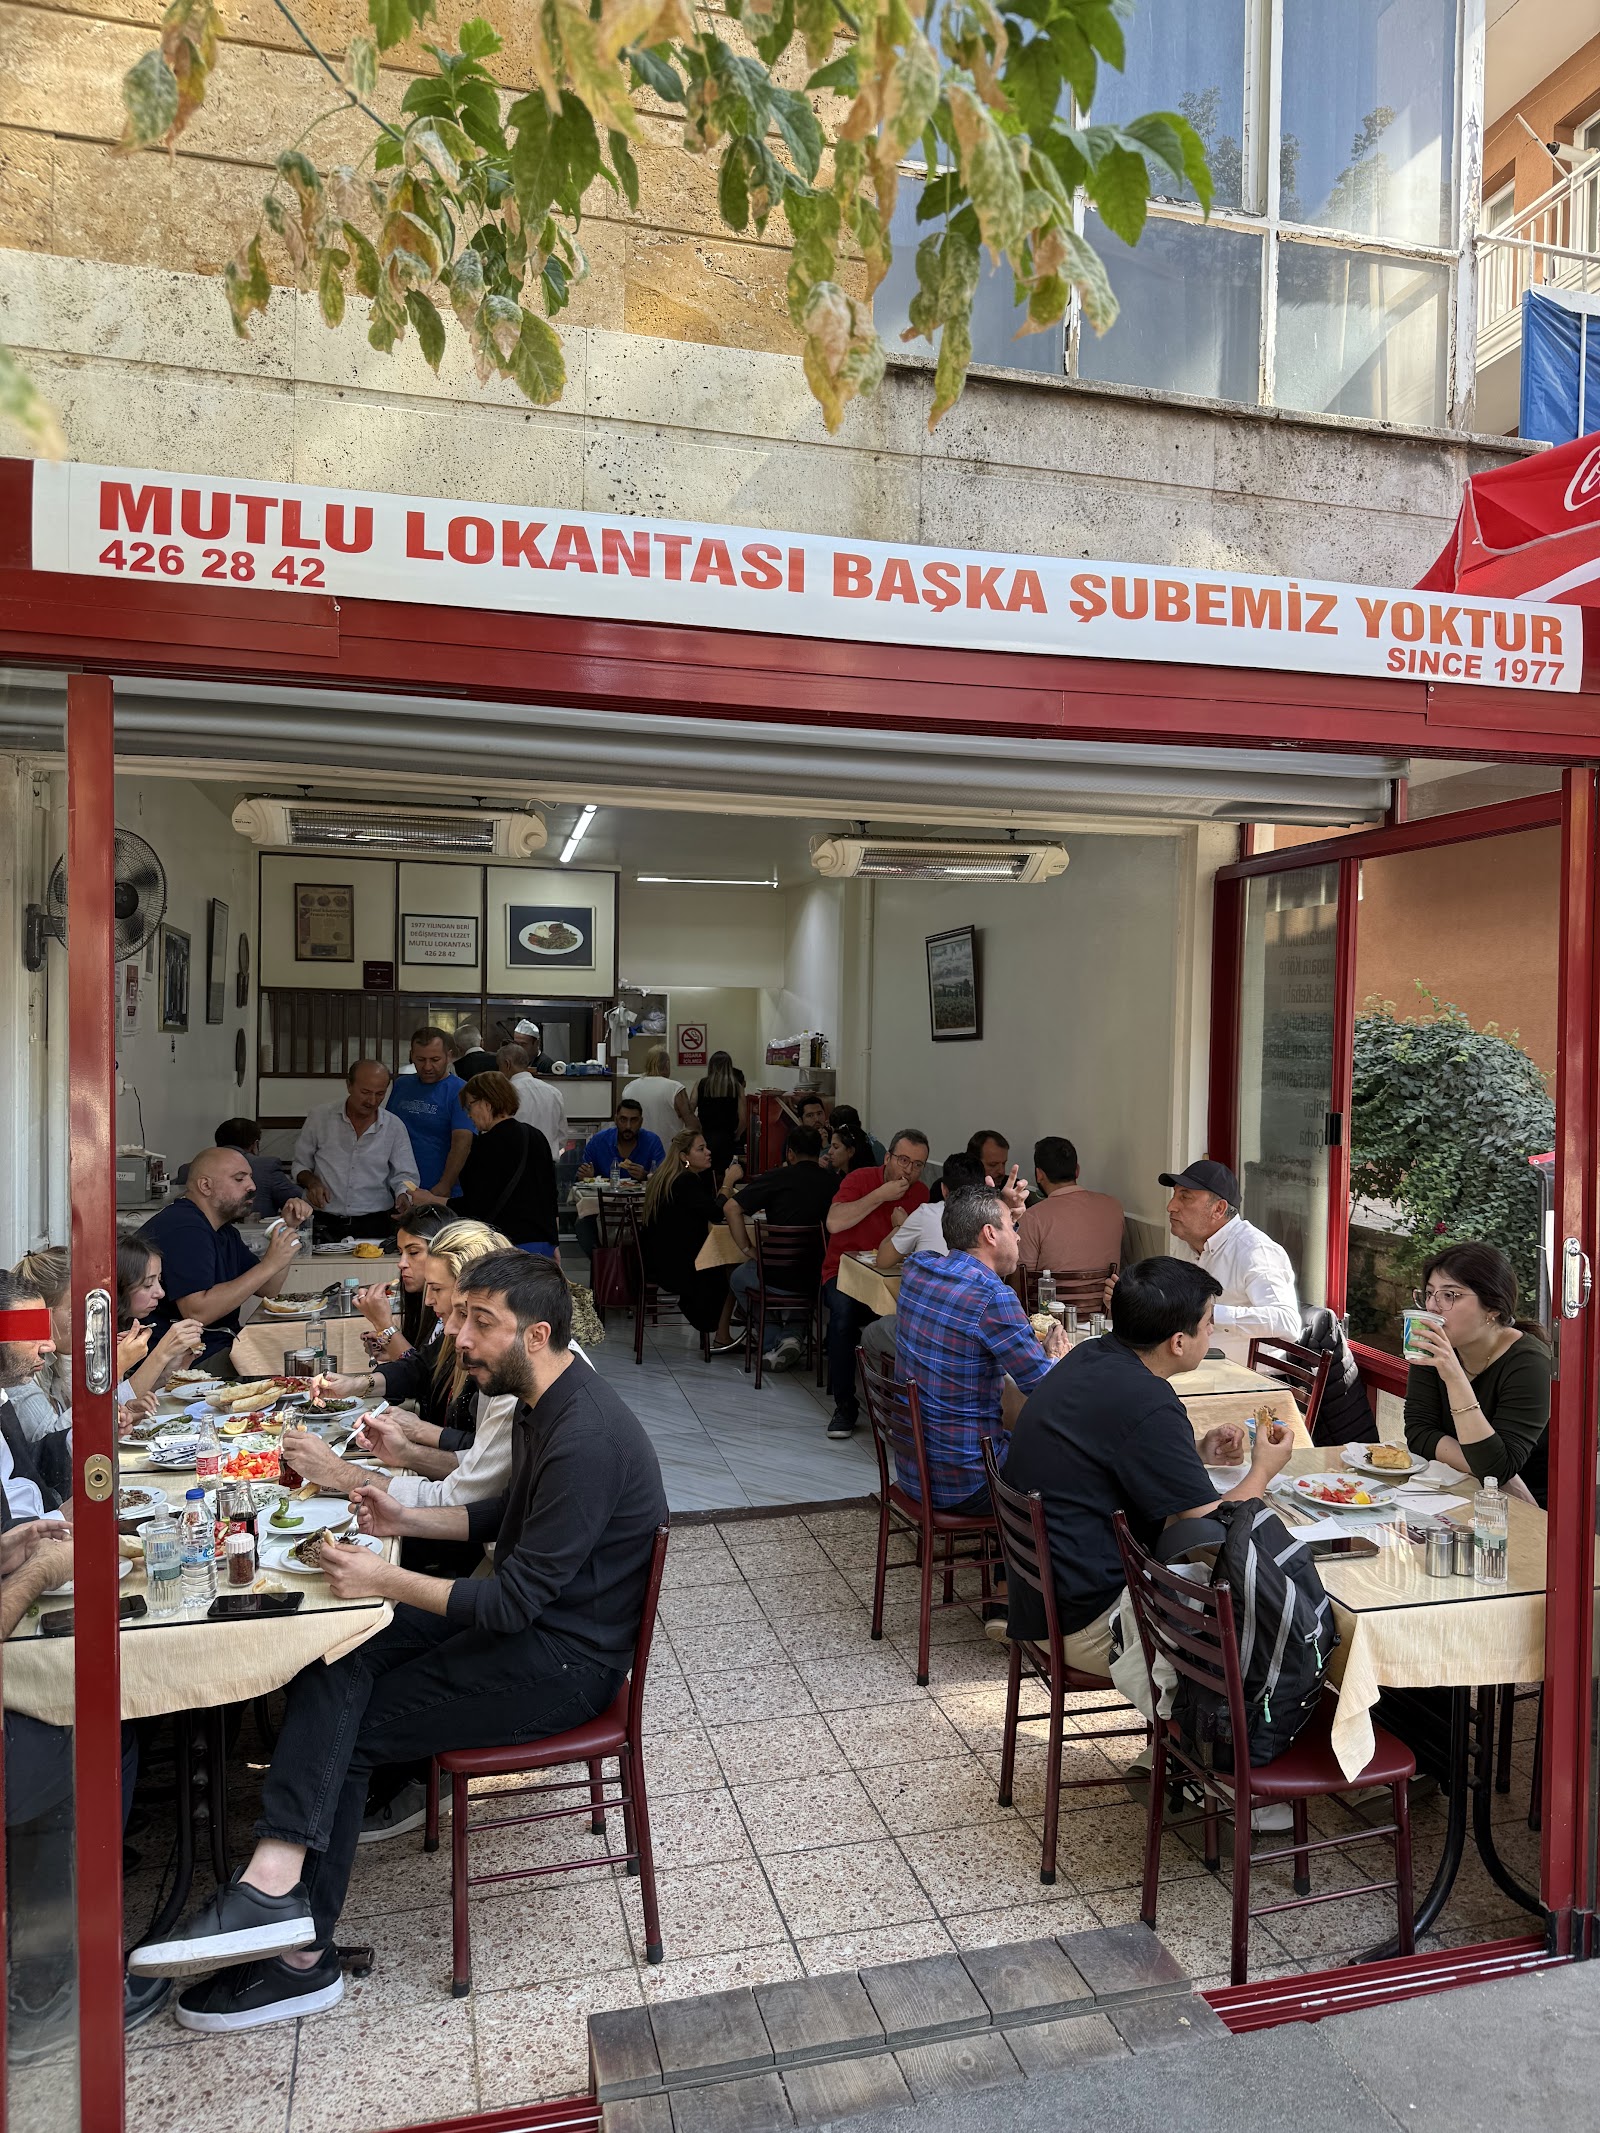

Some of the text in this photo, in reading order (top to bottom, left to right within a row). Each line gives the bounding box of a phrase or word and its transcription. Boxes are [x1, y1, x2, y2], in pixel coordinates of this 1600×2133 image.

[99, 540, 326, 588] 426 28 42
[100, 482, 1563, 656] MUTLU LOKANTASI BAŞKA ŞUBEMİZ YOKTUR
[1387, 647, 1565, 685] SINCE 1977
[410, 931, 449, 939] DEĞİŞMEYEN
